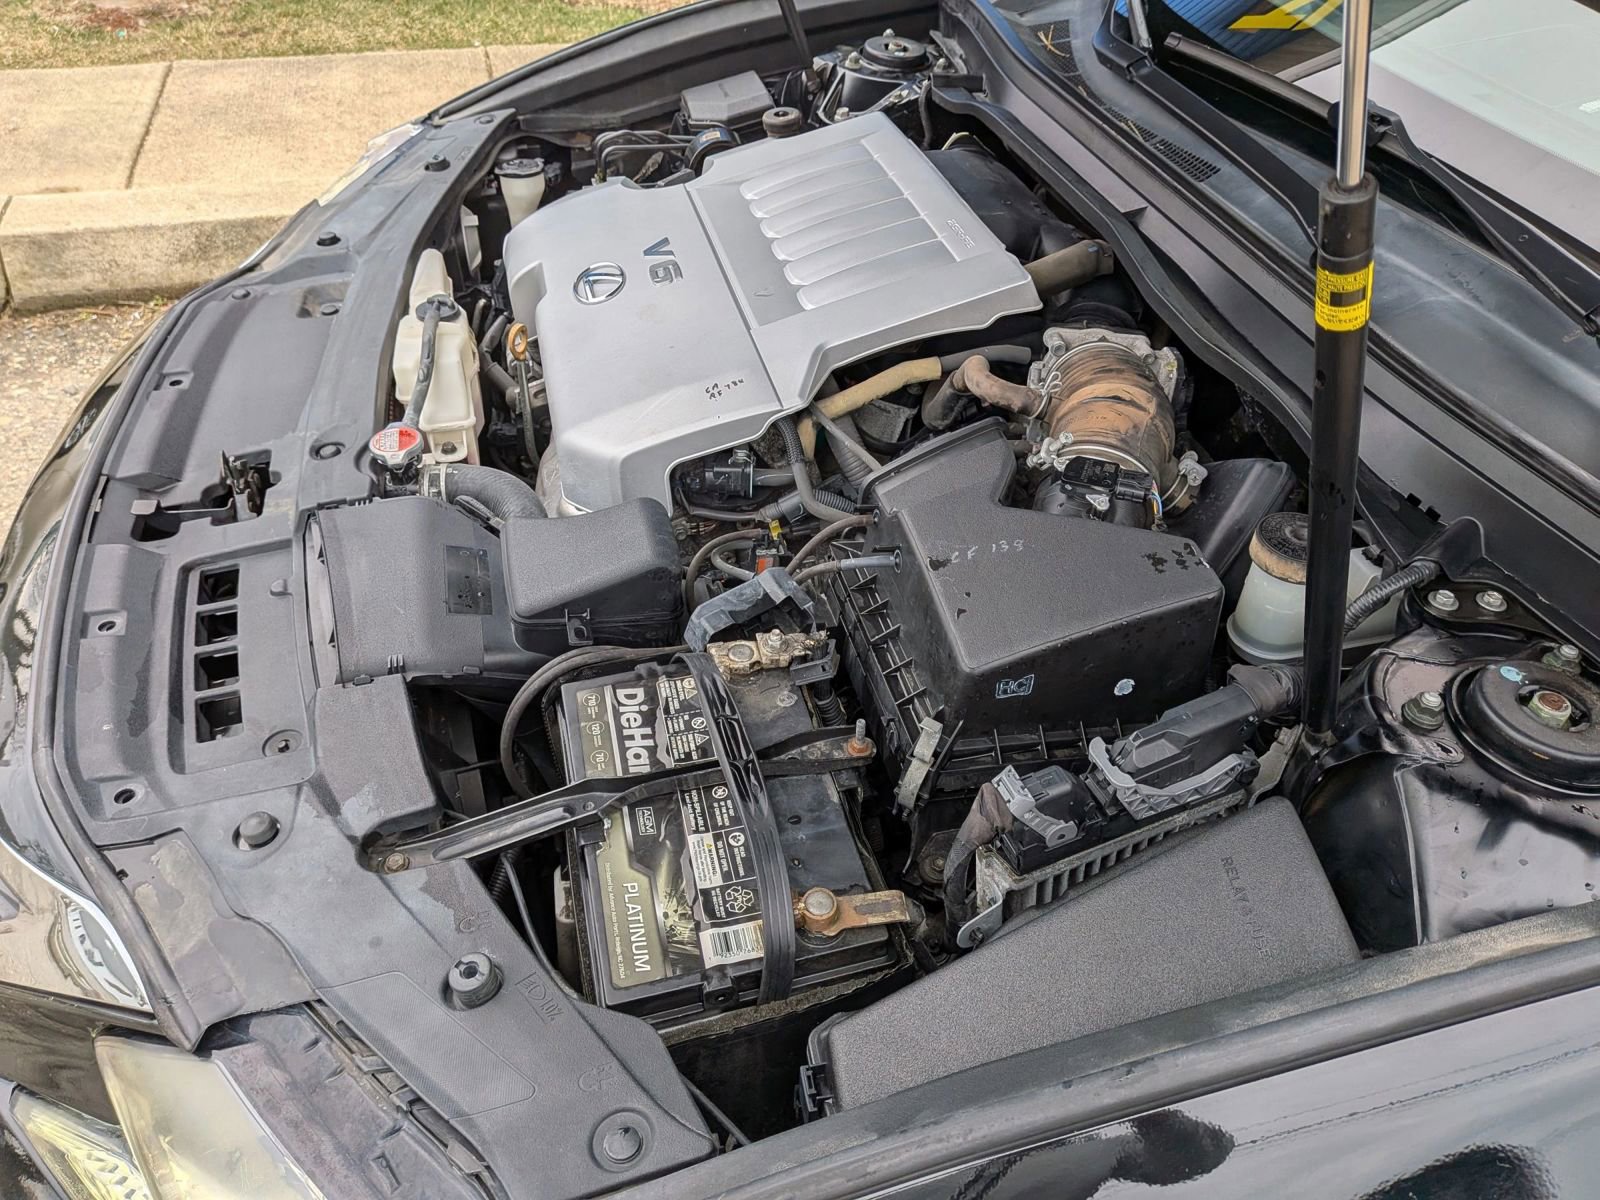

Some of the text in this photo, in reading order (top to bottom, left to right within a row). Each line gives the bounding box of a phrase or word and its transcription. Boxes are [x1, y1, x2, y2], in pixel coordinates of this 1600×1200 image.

[643, 236, 683, 285] V6
[591, 723, 600, 734] 120
[595, 752, 604, 762] 70
[643, 809, 653, 832] AGM
[622, 882, 650, 971] PLATINUM
